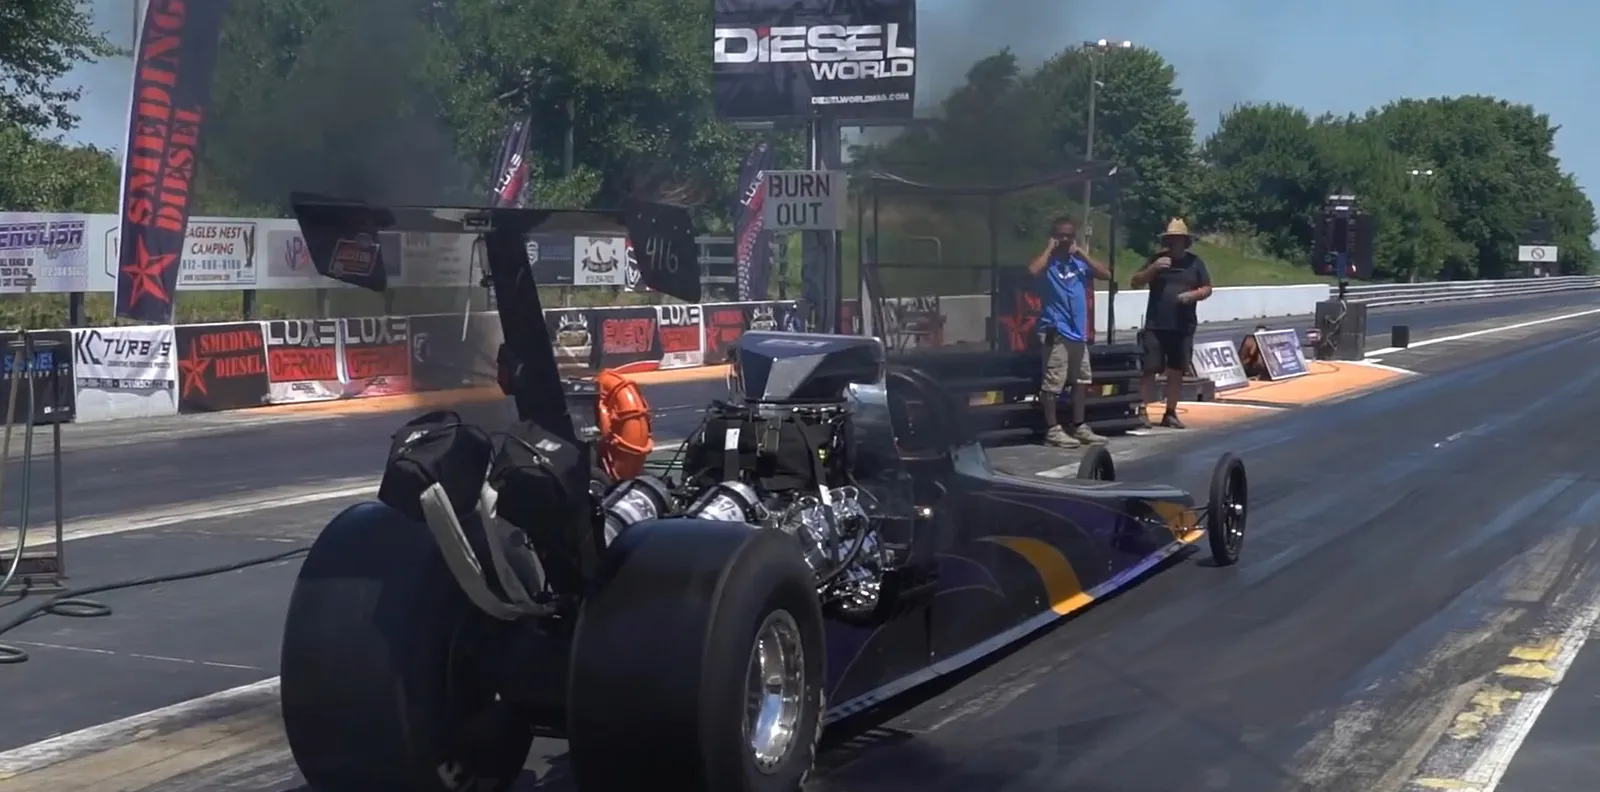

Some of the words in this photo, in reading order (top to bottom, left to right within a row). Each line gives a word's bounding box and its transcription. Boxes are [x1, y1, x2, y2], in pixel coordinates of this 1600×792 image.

[811, 59, 914, 80] WORLD
[154, 106, 204, 232] DIESEL
[768, 174, 830, 197] BURN
[777, 203, 822, 225] OUT
[219, 226, 242, 239] NEST
[191, 242, 234, 255] CAMPING
[645, 236, 679, 273] 416
[658, 304, 701, 326] LUXE
[266, 318, 337, 347] LUXE
[344, 316, 407, 345] LUXE
[75, 329, 103, 365] KC
[103, 338, 172, 359] TURBS
[215, 355, 265, 378] DIESEL
[273, 351, 334, 376] OFFROAD
